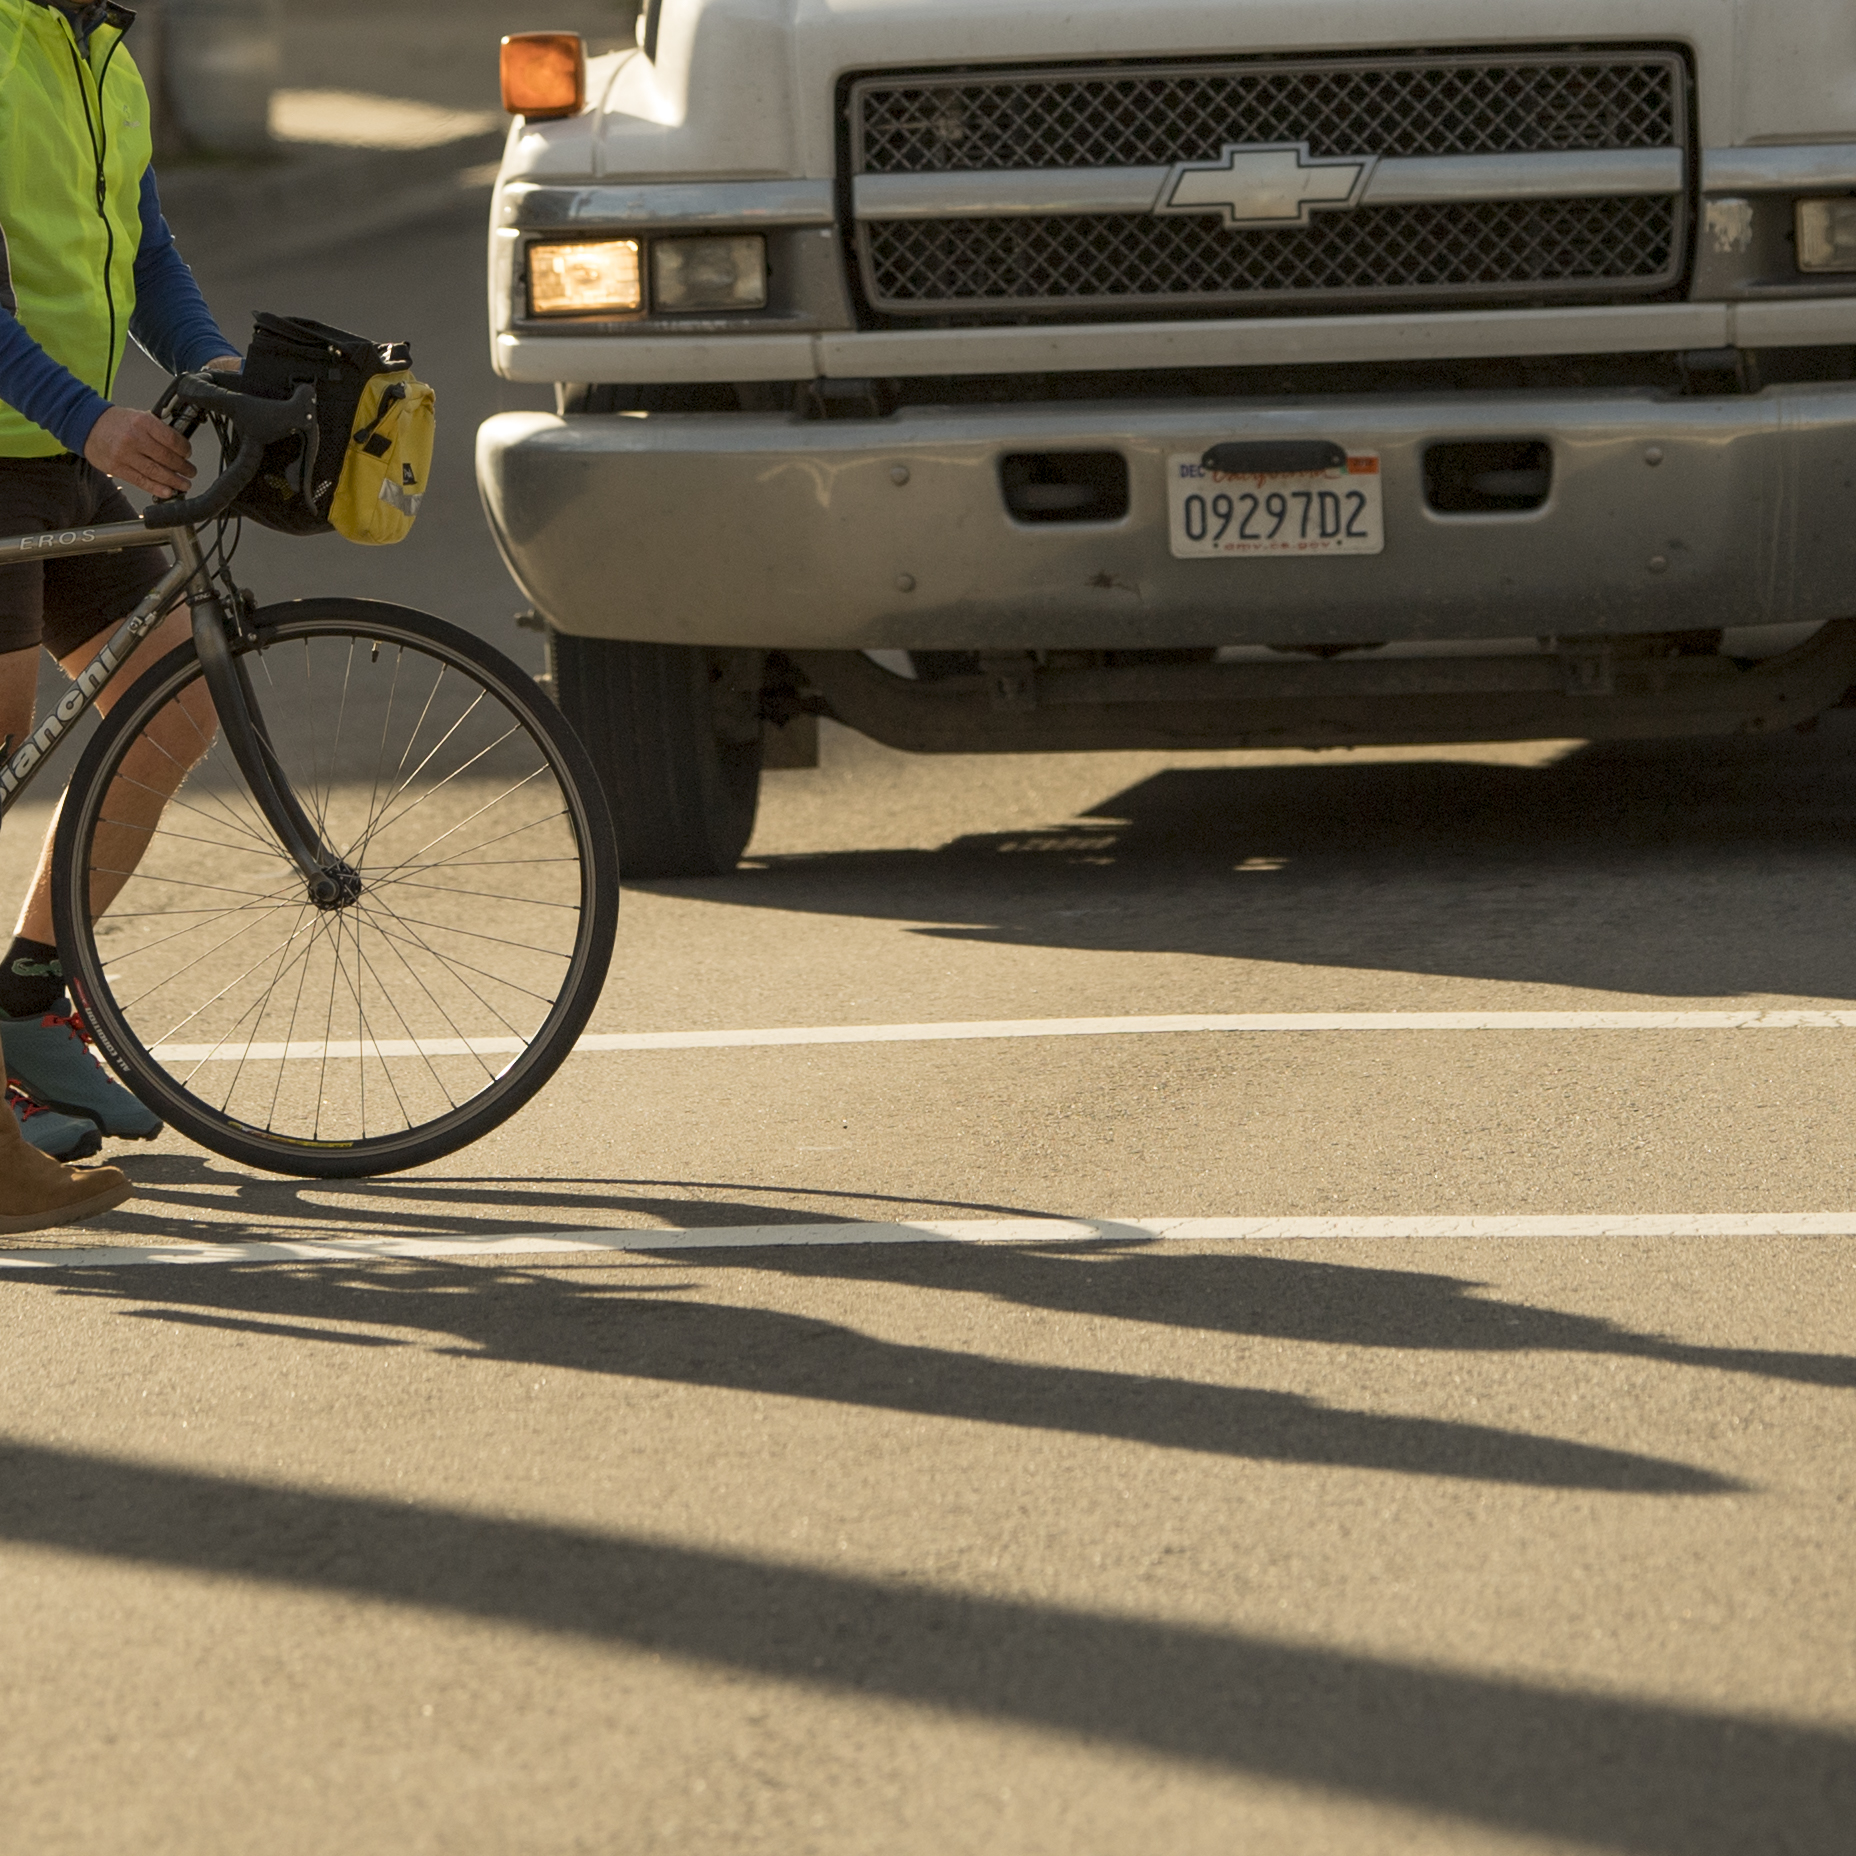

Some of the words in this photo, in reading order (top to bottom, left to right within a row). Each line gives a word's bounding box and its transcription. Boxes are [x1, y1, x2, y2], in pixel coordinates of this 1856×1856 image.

[1180, 464, 1206, 478] DEC
[1184, 490, 1368, 541] 09297D2
[19, 528, 96, 551] EROS
